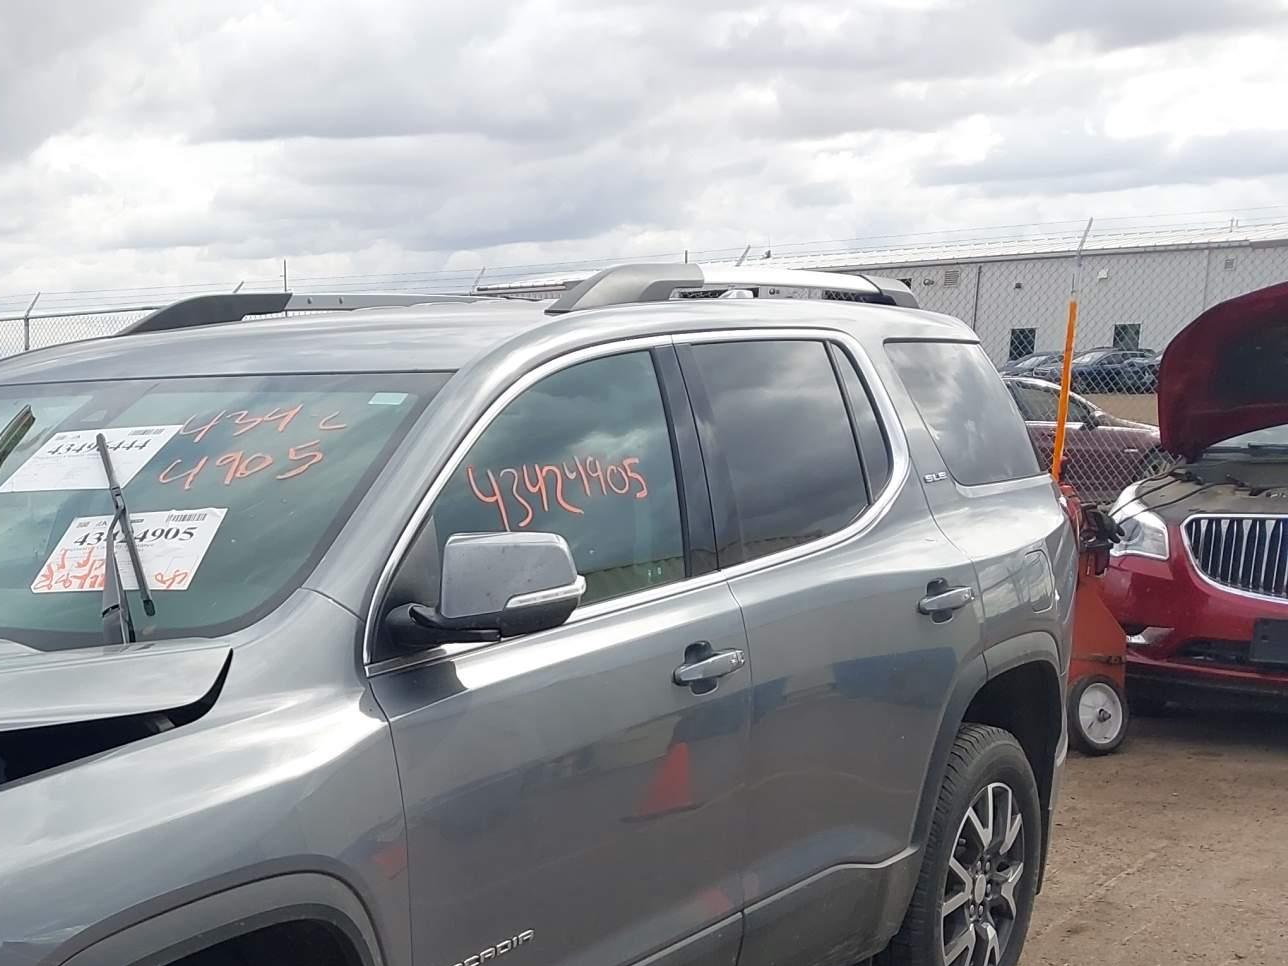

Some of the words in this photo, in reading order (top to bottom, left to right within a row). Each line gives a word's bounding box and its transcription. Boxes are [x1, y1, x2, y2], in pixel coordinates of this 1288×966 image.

[47, 438, 152, 455] 4349444
[159, 439, 324, 490] 4905
[466, 455, 647, 532] 43424905
